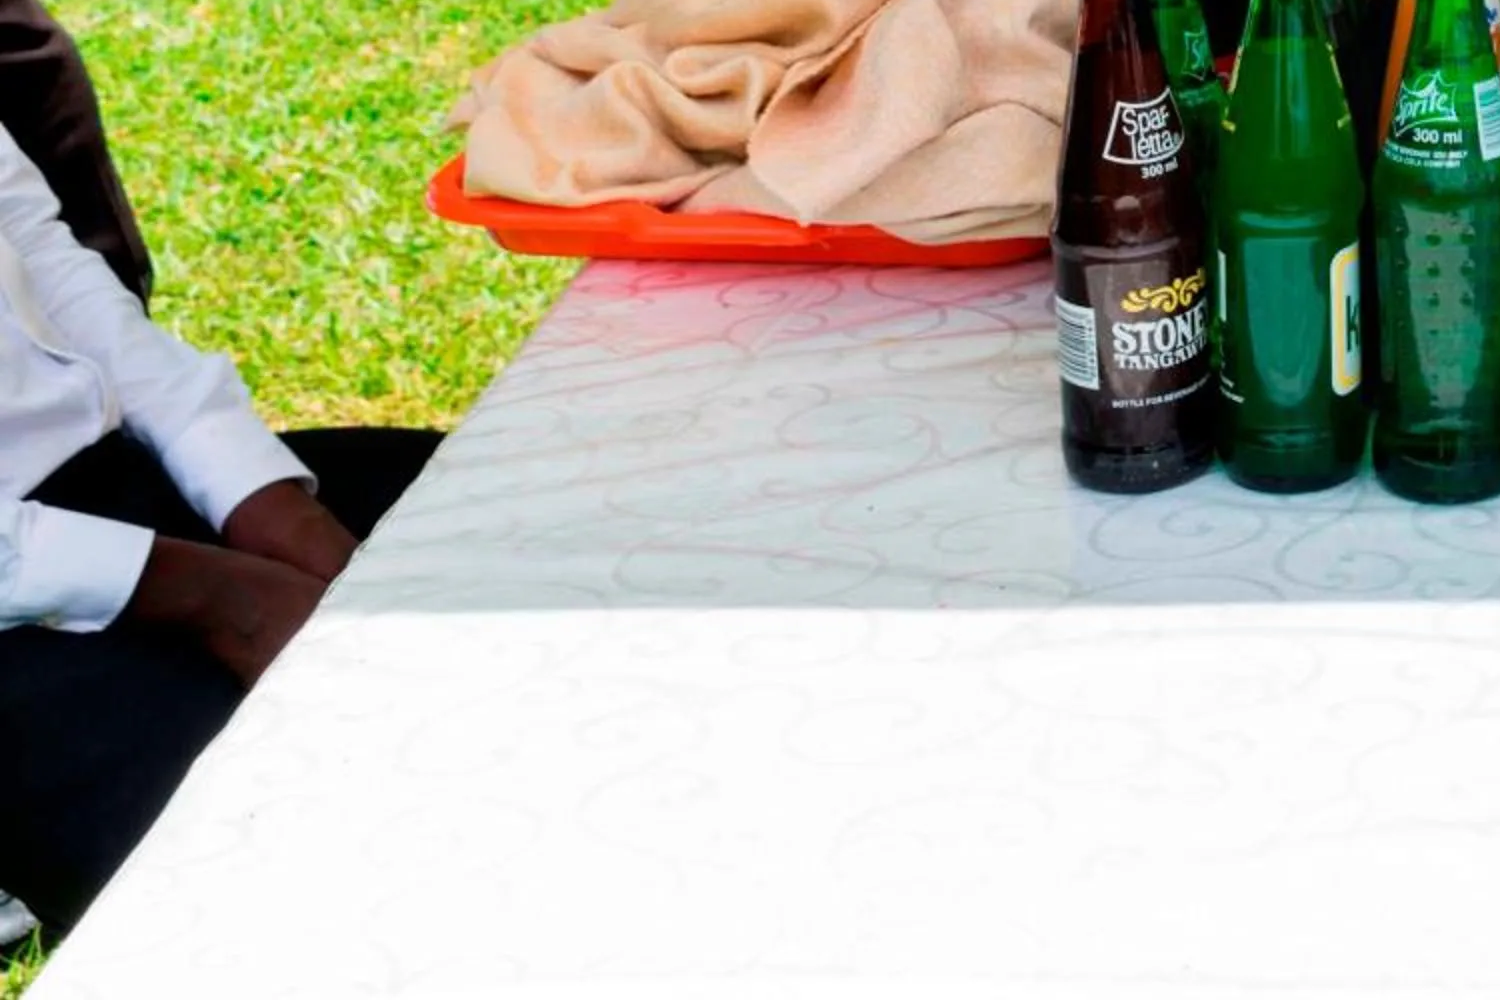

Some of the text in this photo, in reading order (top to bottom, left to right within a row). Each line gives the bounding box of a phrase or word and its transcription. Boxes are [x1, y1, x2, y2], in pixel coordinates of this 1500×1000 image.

[1412, 127, 1463, 144] 300 ml
[1141, 163, 1164, 179] 300
